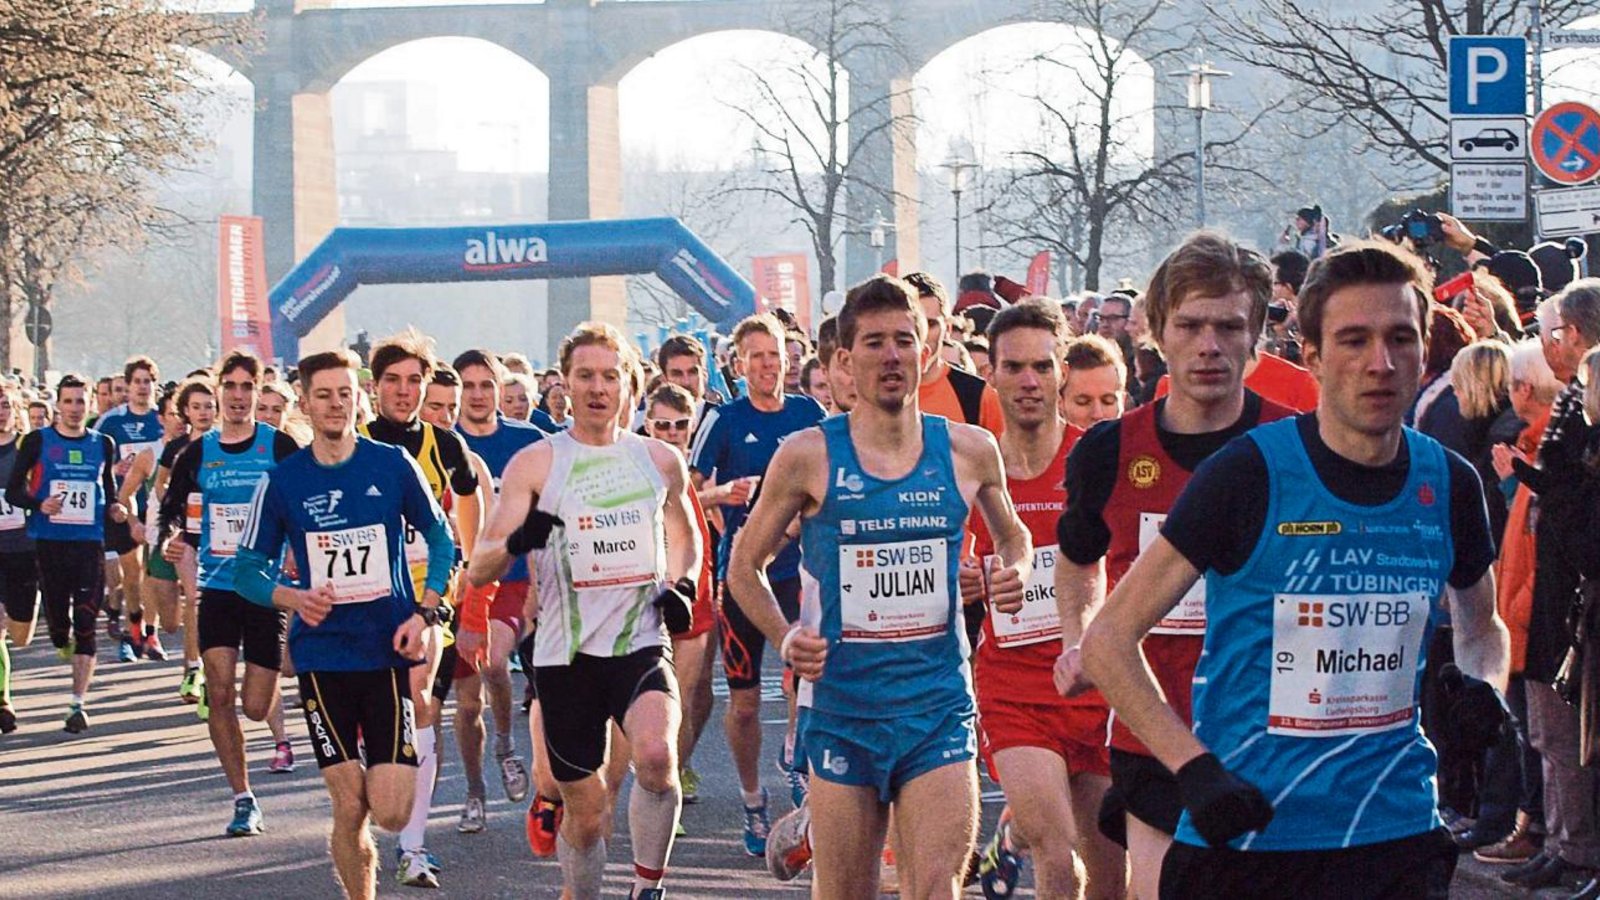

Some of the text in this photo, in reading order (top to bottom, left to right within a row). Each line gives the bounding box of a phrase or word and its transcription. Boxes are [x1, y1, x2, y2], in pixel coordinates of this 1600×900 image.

[1467, 47, 1508, 105] P
[465, 232, 548, 265] alwa
[229, 224, 250, 338] BIETIGHEIMER
[60, 491, 87, 509] 748
[898, 491, 941, 503] KION
[859, 516, 948, 531] TELIS FINANZ
[593, 540, 636, 556] Marco
[1330, 548, 1373, 565] LAV
[324, 545, 371, 578] 717
[869, 568, 934, 599] JULIAN
[1330, 570, 1439, 594] TÜBINGEN
[1025, 584, 1056, 602] eiko
[1276, 651, 1294, 675] 19
[1316, 646, 1405, 675] Michael
[1326, 693, 1388, 705] Kreissparkasse
[1325, 706, 1380, 717] Ludwigsburg
